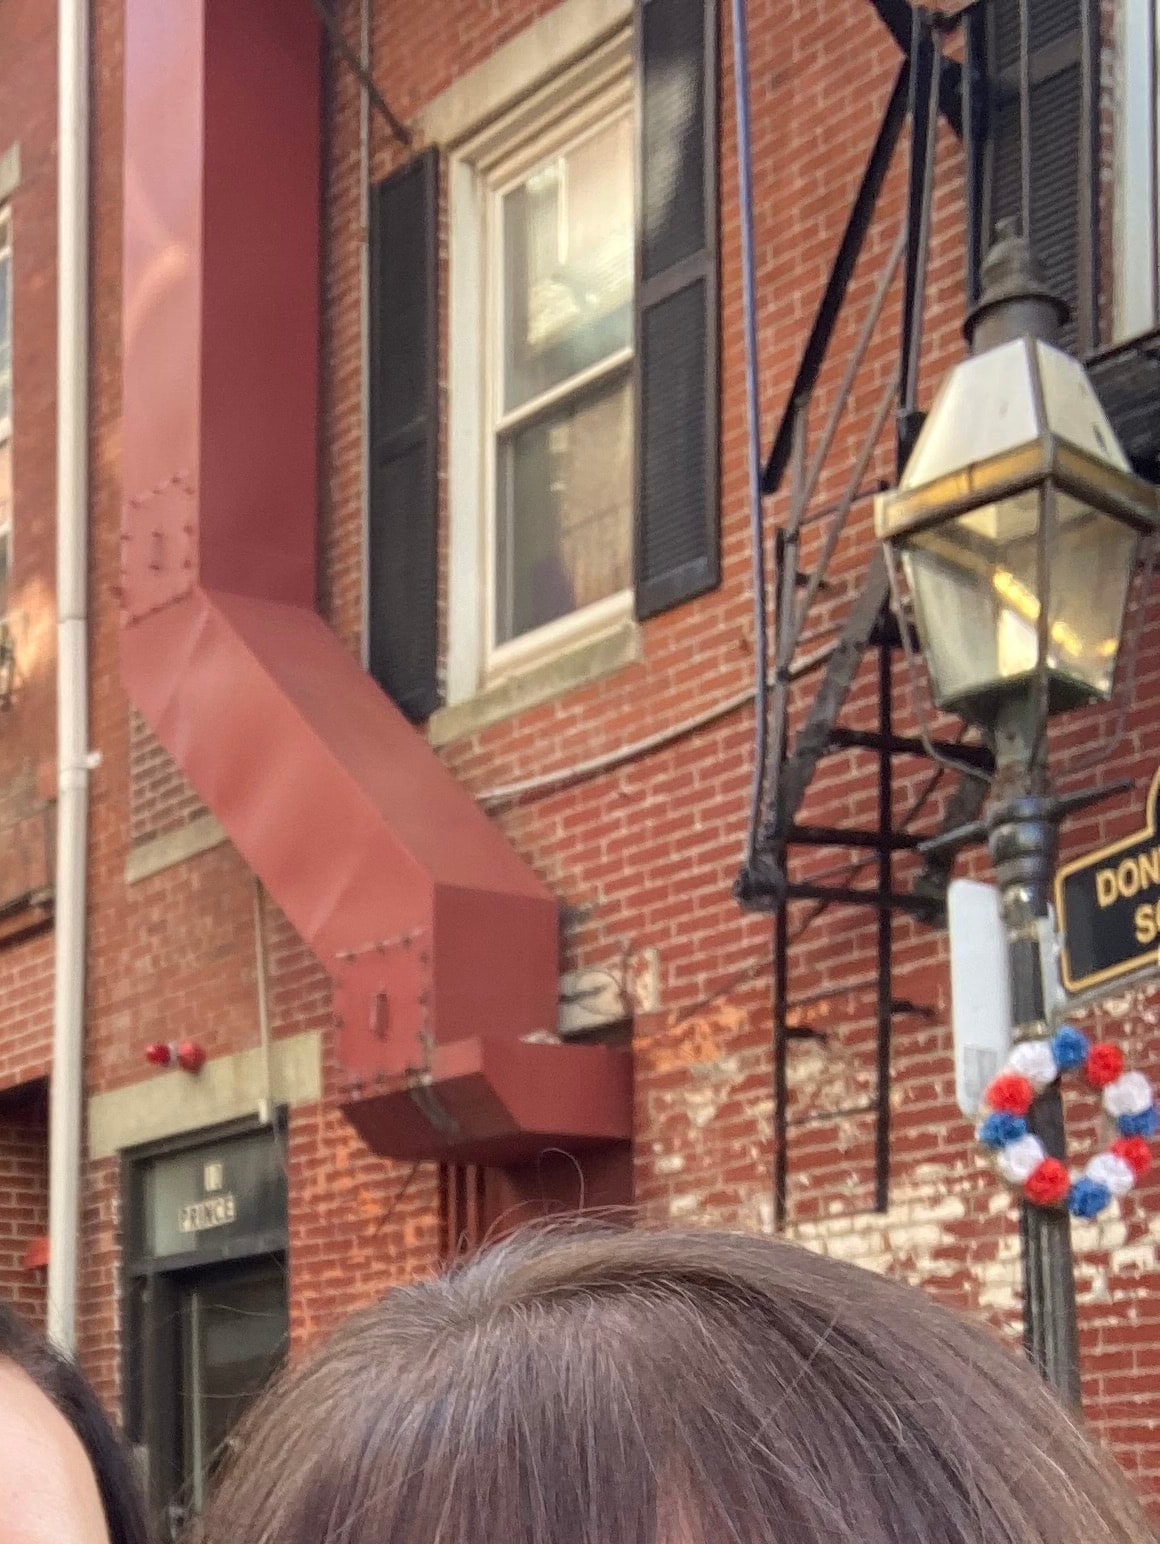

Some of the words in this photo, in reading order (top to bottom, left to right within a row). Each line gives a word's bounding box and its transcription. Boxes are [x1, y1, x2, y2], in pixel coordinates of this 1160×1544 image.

[1096, 848, 1160, 908] DON
[1133, 900, 1160, 945] S
[179, 1194, 236, 1232] PRINCE
